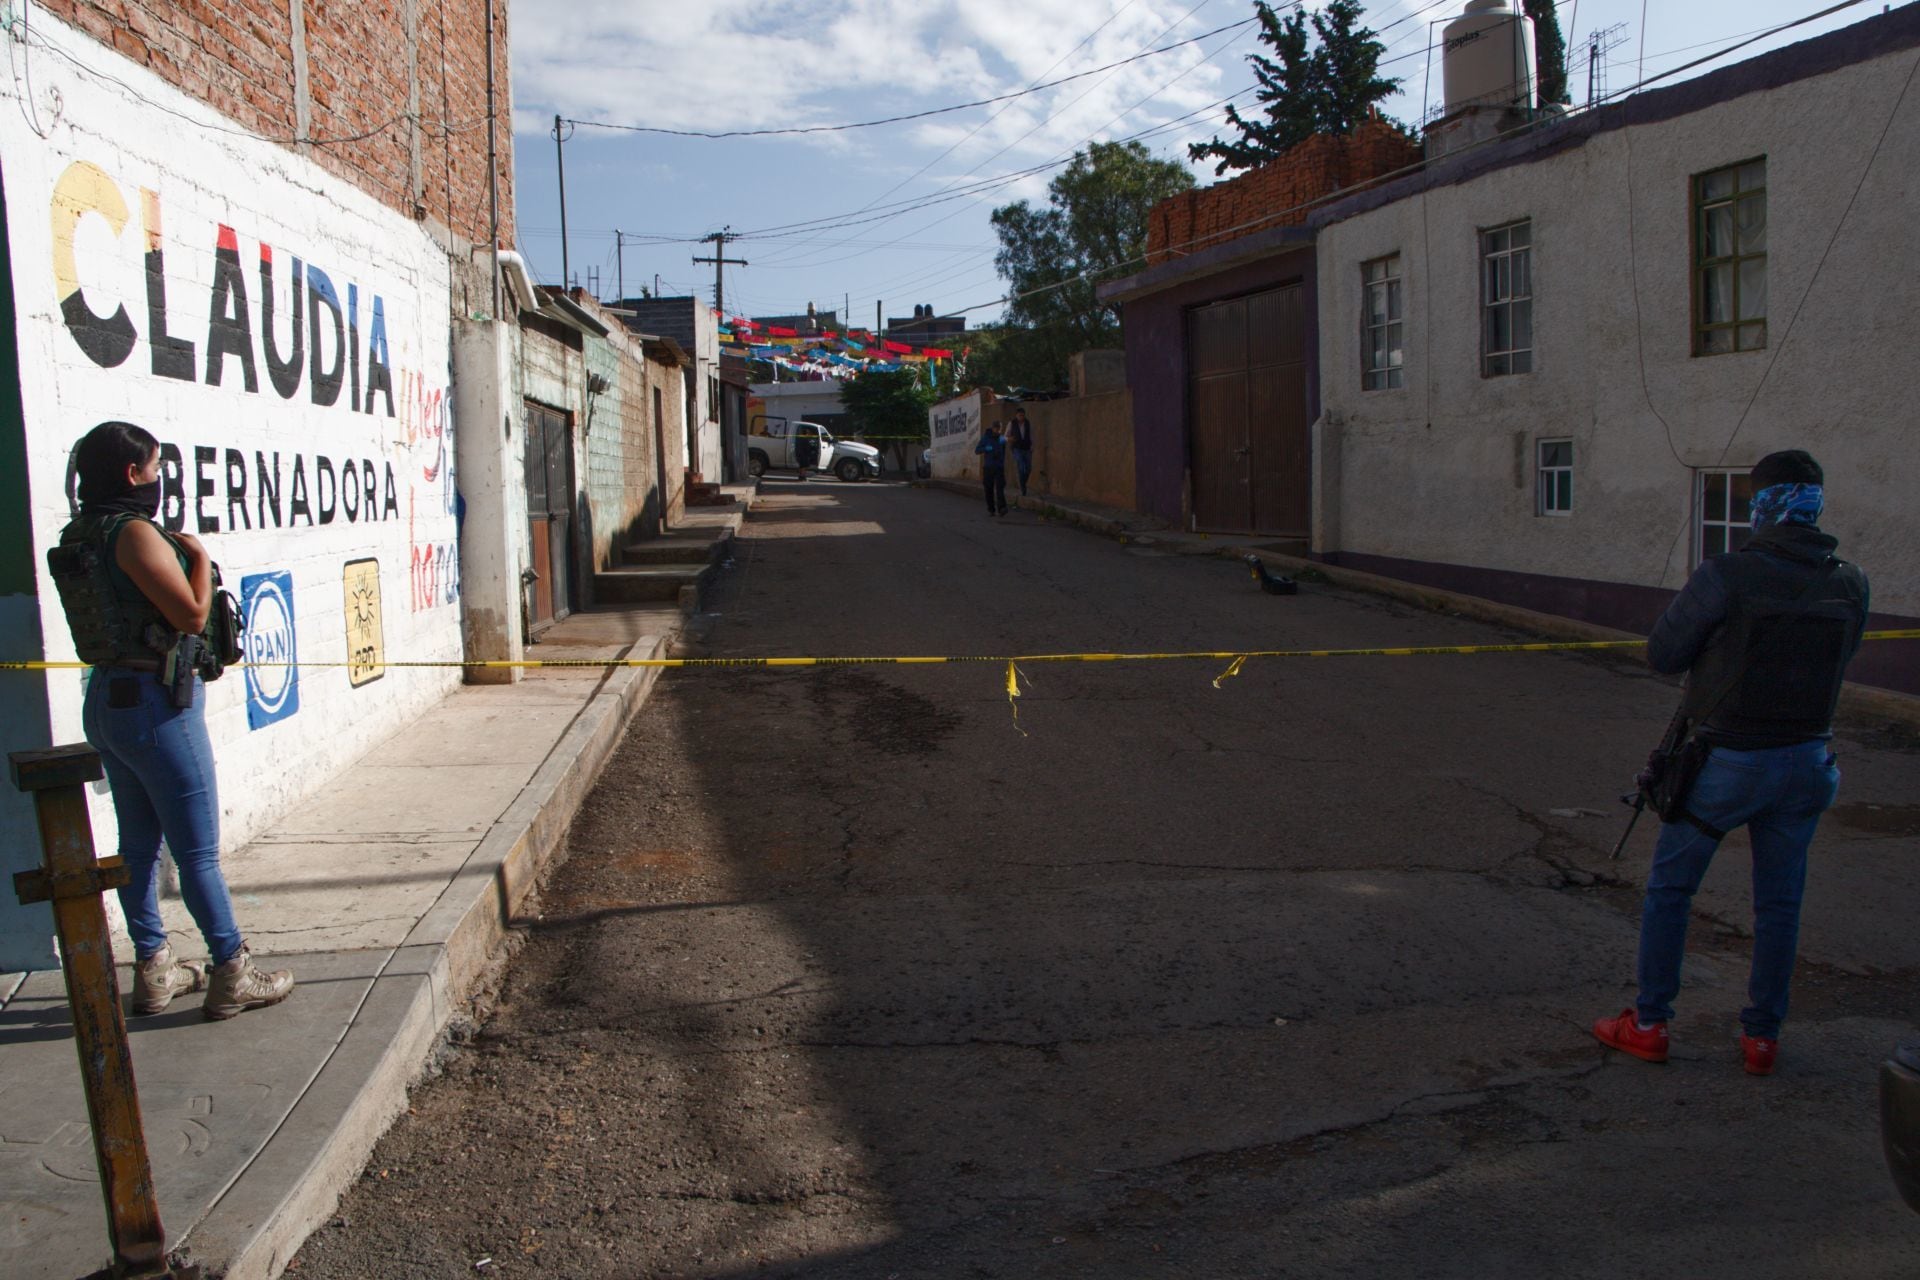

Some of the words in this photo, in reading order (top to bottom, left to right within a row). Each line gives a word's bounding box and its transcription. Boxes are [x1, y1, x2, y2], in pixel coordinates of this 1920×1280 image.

[50, 160, 394, 417] CLAUDIA
[66, 440, 398, 533] BERNADORA
[255, 628, 287, 670] PAN
[354, 645, 376, 677] PRD
